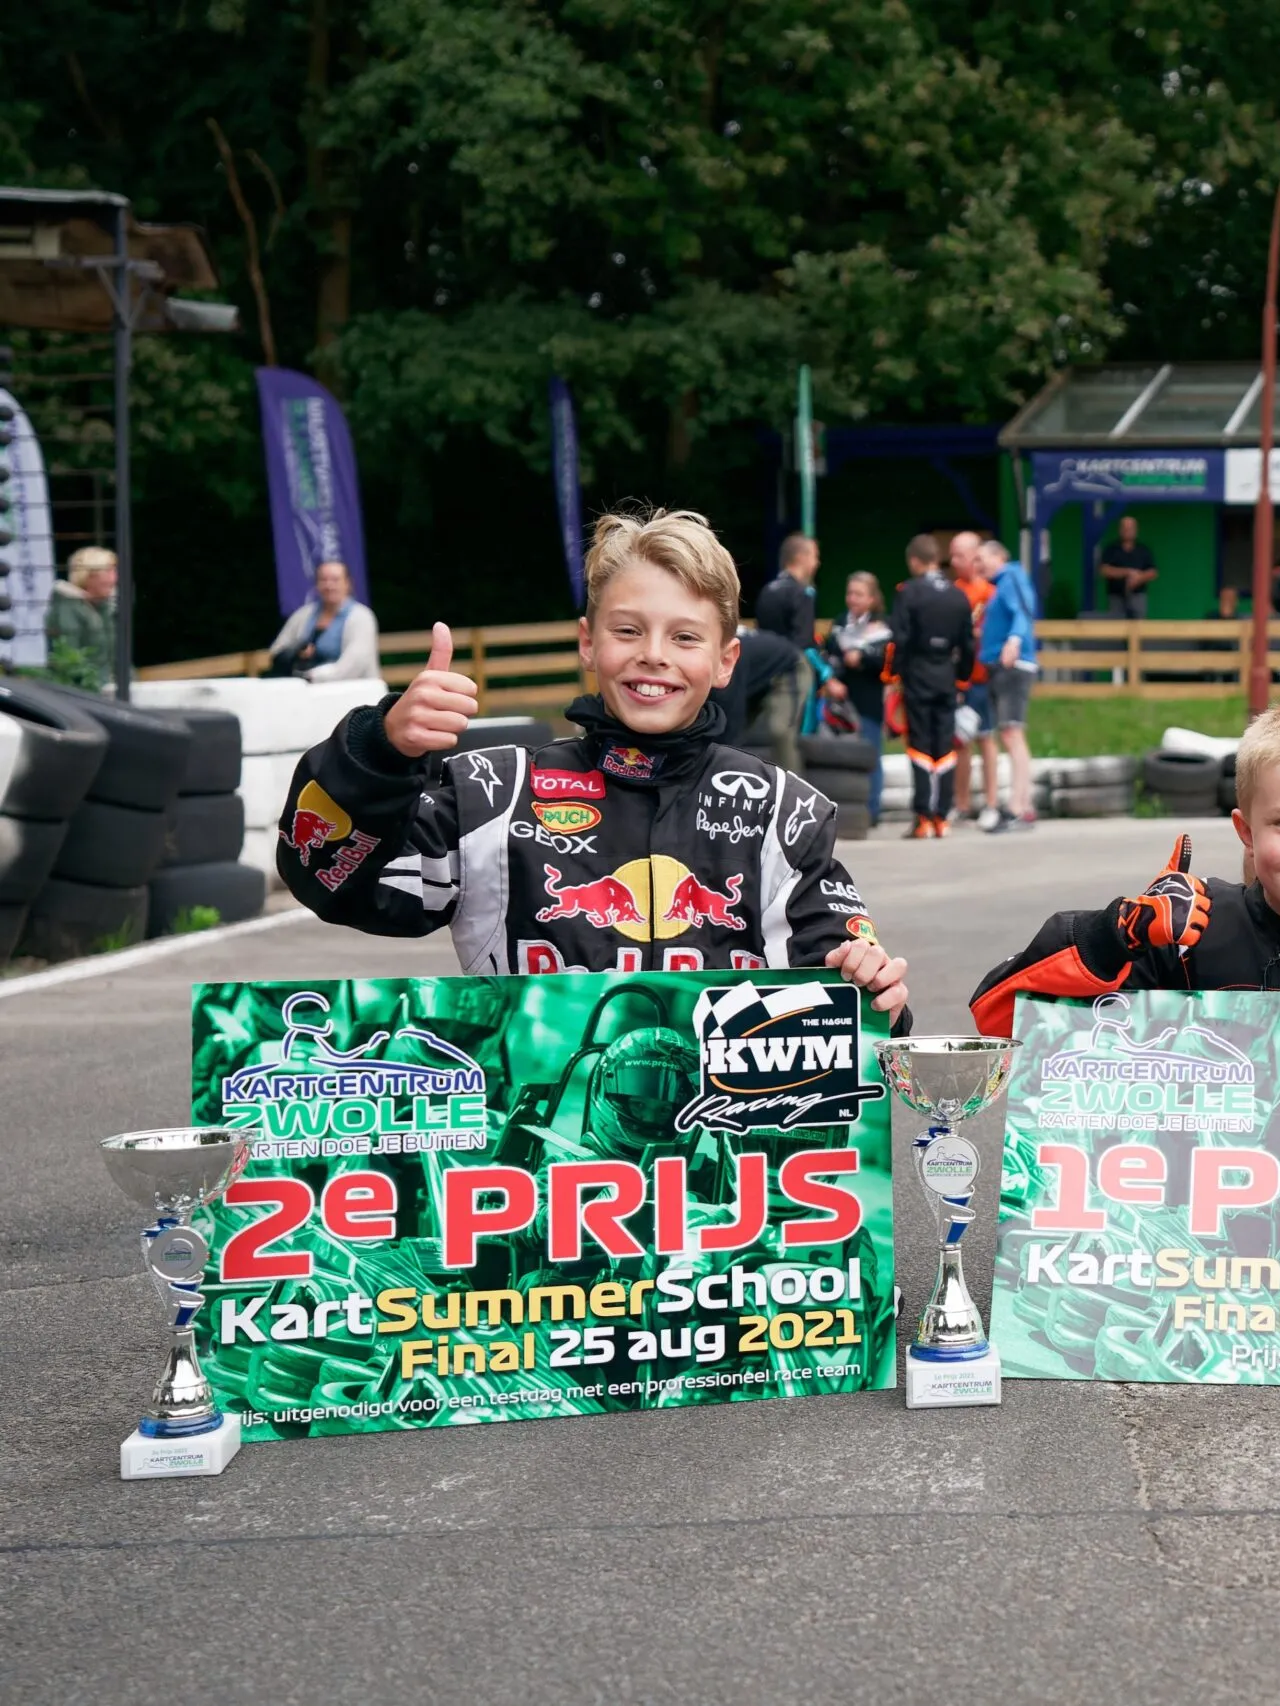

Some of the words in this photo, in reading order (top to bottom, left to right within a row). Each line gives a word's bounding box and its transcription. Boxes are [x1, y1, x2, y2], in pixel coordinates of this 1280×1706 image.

[533, 773, 601, 792] TOTAL
[543, 809, 591, 825] RAUCH
[728, 815, 765, 844] Jean
[509, 820, 598, 854] GEOX
[802, 1018, 820, 1027] THE
[821, 1017, 853, 1026] HAGUE
[706, 1034, 854, 1074] KWM
[1042, 1058, 1254, 1082] KARTCENTRUM
[222, 1070, 486, 1102] KARTCENTRUM
[1040, 1081, 1255, 1114] ZWOLLE
[222, 1095, 486, 1139] ZWOLLE
[682, 1089, 882, 1128] Racing
[838, 1108, 854, 1118] NL
[1038, 1113, 1117, 1130] KARTEN
[1117, 1114, 1157, 1130] DOE
[1159, 1115, 1185, 1131] JE
[1185, 1115, 1254, 1132] BUITEN
[250, 1139, 318, 1158] RTEN
[323, 1137, 369, 1155] DOE
[372, 1135, 402, 1154] JE
[402, 1132, 486, 1152] BUITEN
[1030, 1143, 1168, 1231] 1e
[220, 1167, 398, 1281] 2e
[441, 1147, 863, 1268] PRIJS
[220, 1258, 862, 1346] KartSummerSchool
[401, 1332, 536, 1379] Final
[549, 1326, 615, 1368] 25
[627, 1322, 727, 1363] aug
[737, 1309, 862, 1353] 2021
[242, 1410, 269, 1427] ijs:
[273, 1399, 395, 1425] uitgenodigd
[398, 1396, 443, 1413] voor
[449, 1394, 485, 1408] een
[489, 1386, 562, 1406] testdag
[566, 1382, 602, 1399] met
[607, 1380, 642, 1396] een
[647, 1370, 769, 1395] professioneel
[773, 1366, 811, 1382] race
[815, 1363, 861, 1378] team
[931, 1380, 993, 1390] KARTCENTRUM
[952, 1387, 993, 1395] ZWOLLE
[150, 1453, 204, 1463] KARTCENTRUM
